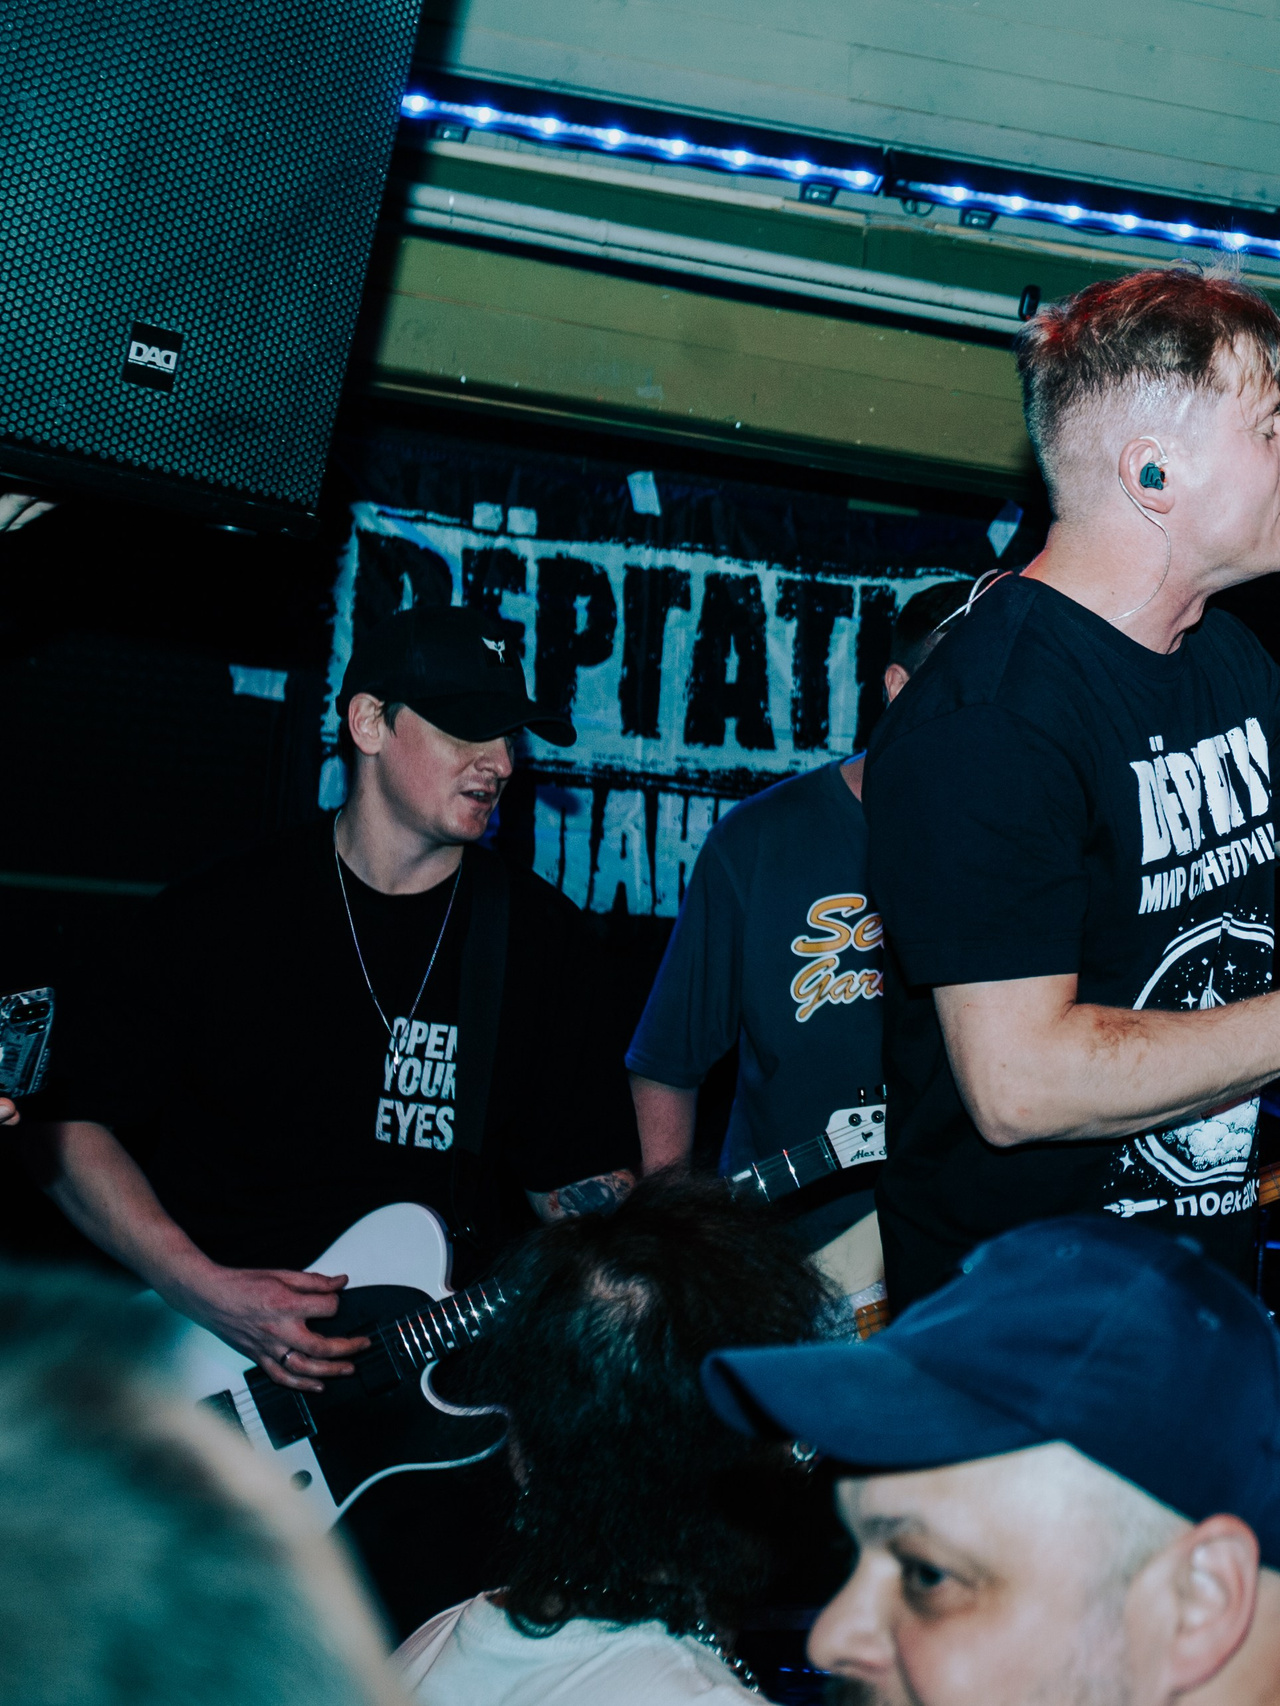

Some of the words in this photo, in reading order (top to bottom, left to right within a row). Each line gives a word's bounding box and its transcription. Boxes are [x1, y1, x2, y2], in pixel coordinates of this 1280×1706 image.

[1138, 866, 1187, 914] МИР
[790, 954, 884, 1023] Gar
[375, 1098, 455, 1151] EYES
